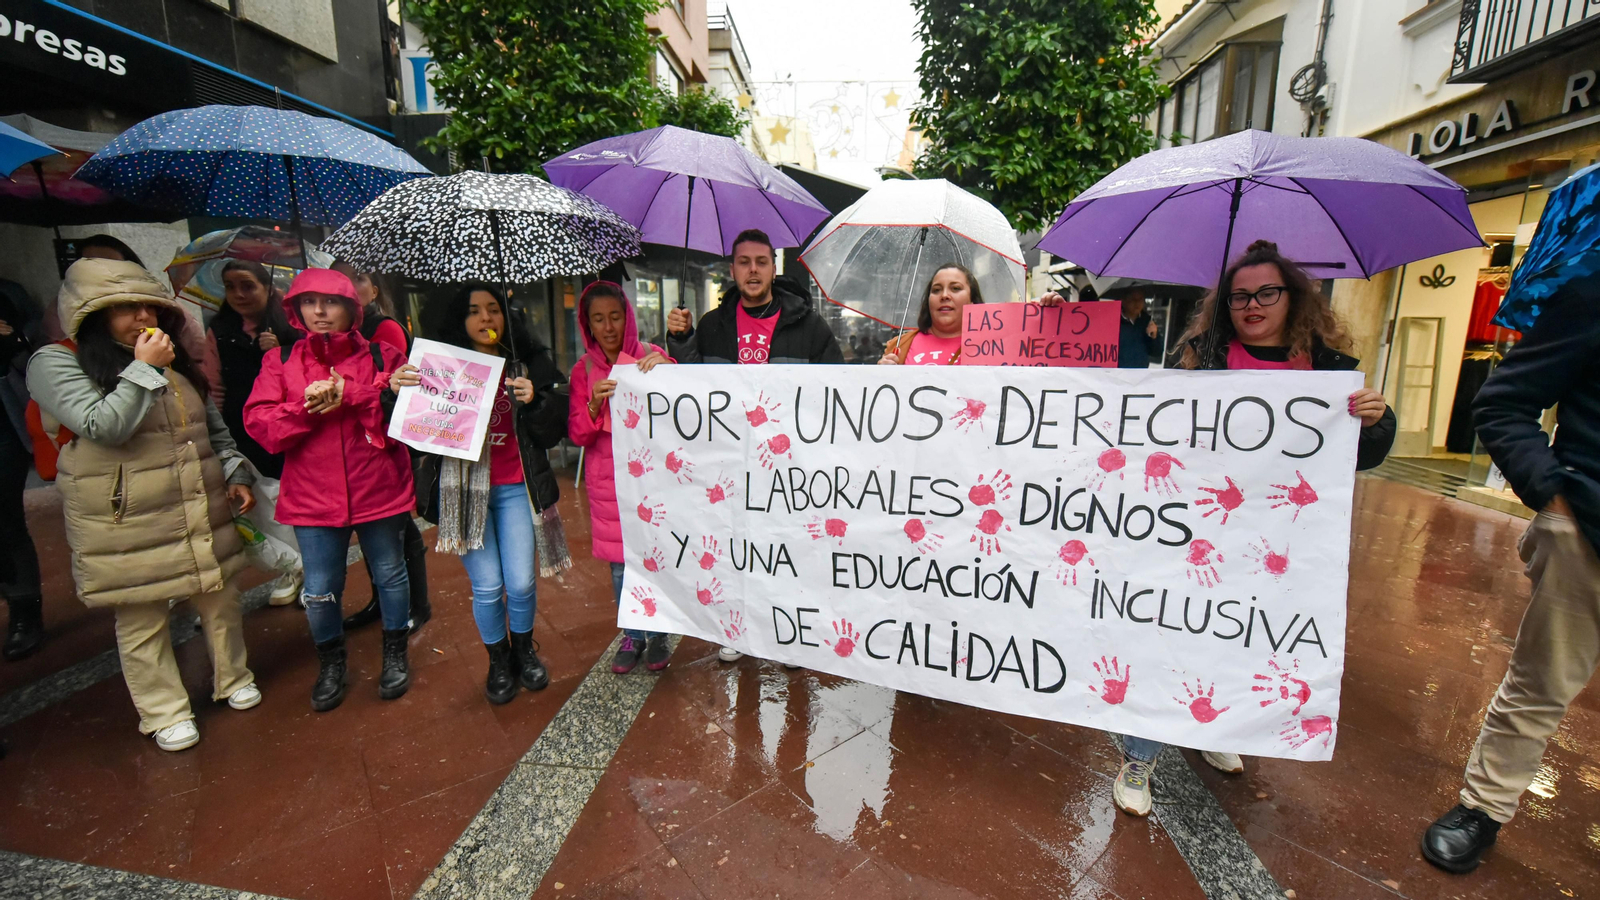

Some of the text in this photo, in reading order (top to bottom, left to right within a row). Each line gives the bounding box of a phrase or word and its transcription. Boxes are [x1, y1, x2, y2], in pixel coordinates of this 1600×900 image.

[1407, 100, 1513, 160] LOLA
[968, 303, 1090, 336] LAS PTIS
[737, 333, 770, 349] TI
[964, 336, 1118, 363] SON NECESARIAS
[420, 367, 456, 379] TENER
[419, 383, 477, 405] NO ES UN
[429, 401, 458, 415] LUJO
[646, 383, 1331, 459] POR UNOS DERECHOS
[408, 423, 465, 442] NECESIDAD
[422, 416, 454, 430] ES UNA
[745, 466, 965, 518] LABORALES
[671, 530, 690, 569] Y
[730, 538, 799, 578] UNA
[772, 606, 820, 648] DE
